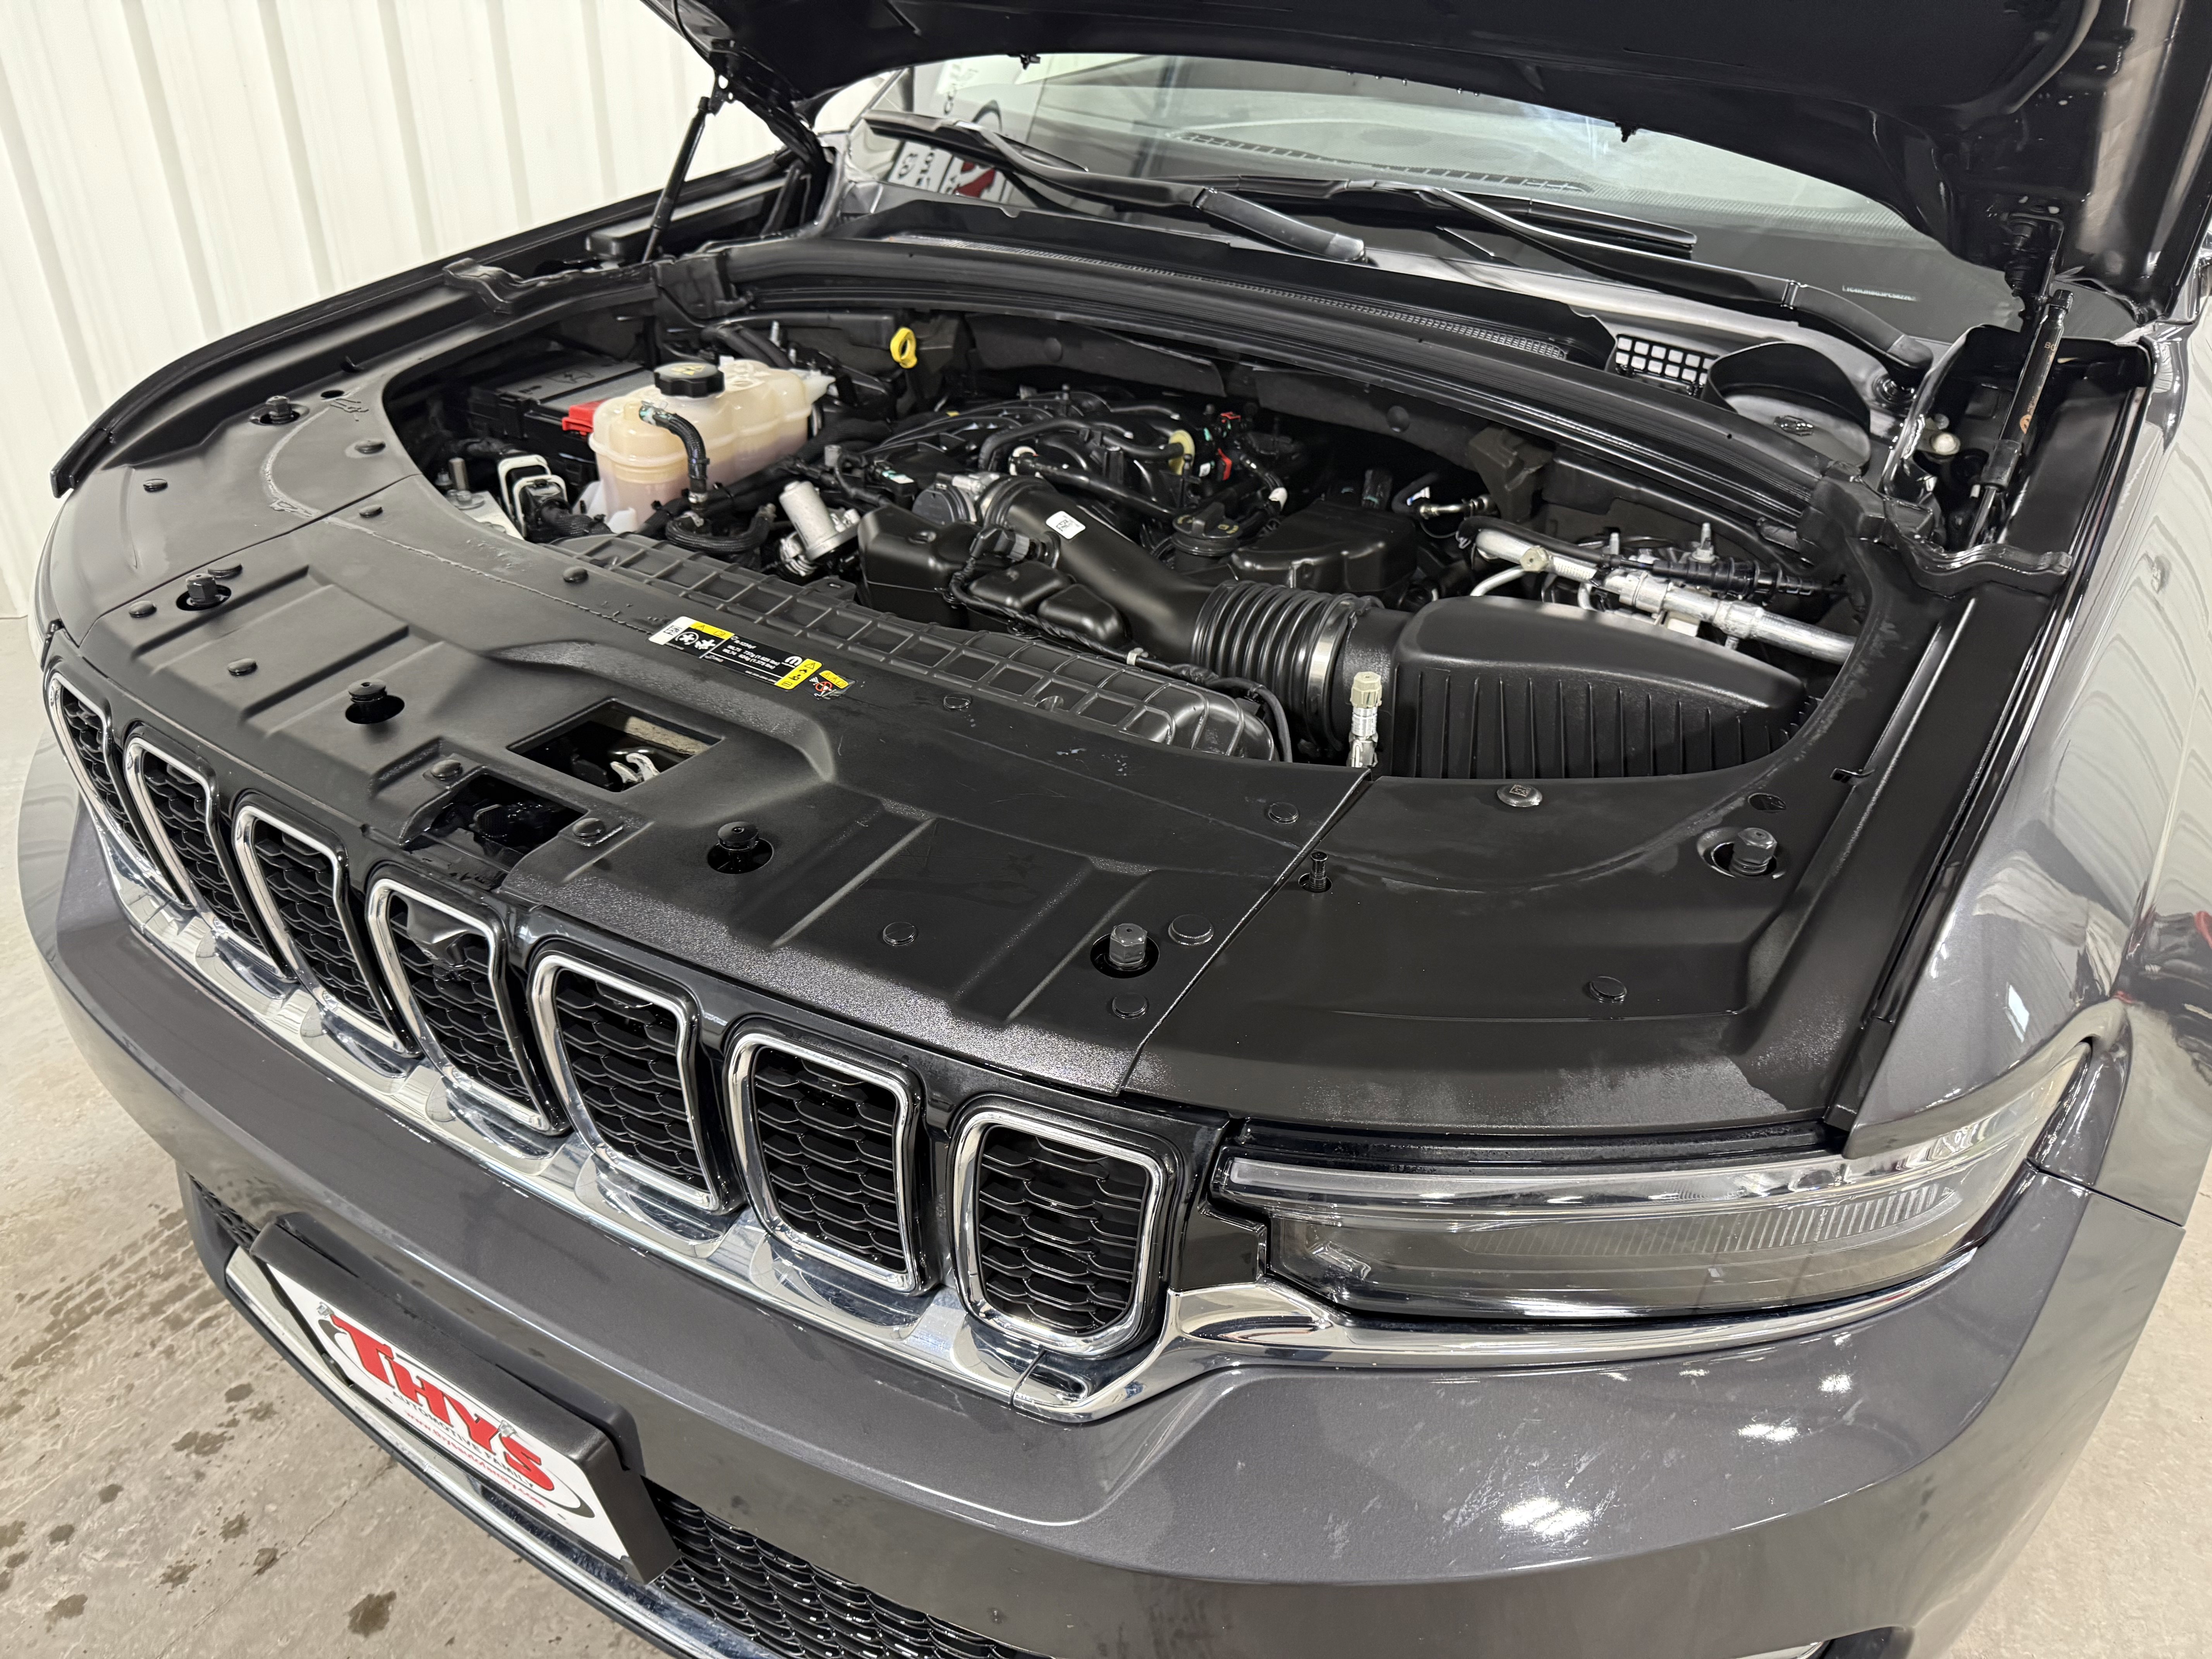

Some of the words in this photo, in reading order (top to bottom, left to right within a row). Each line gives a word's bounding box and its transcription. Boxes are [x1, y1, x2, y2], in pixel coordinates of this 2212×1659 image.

[330, 1314, 555, 1491] THYS
[393, 1391, 482, 1454] AUTOMOTIVE
[484, 1451, 534, 1488] FAMILY
